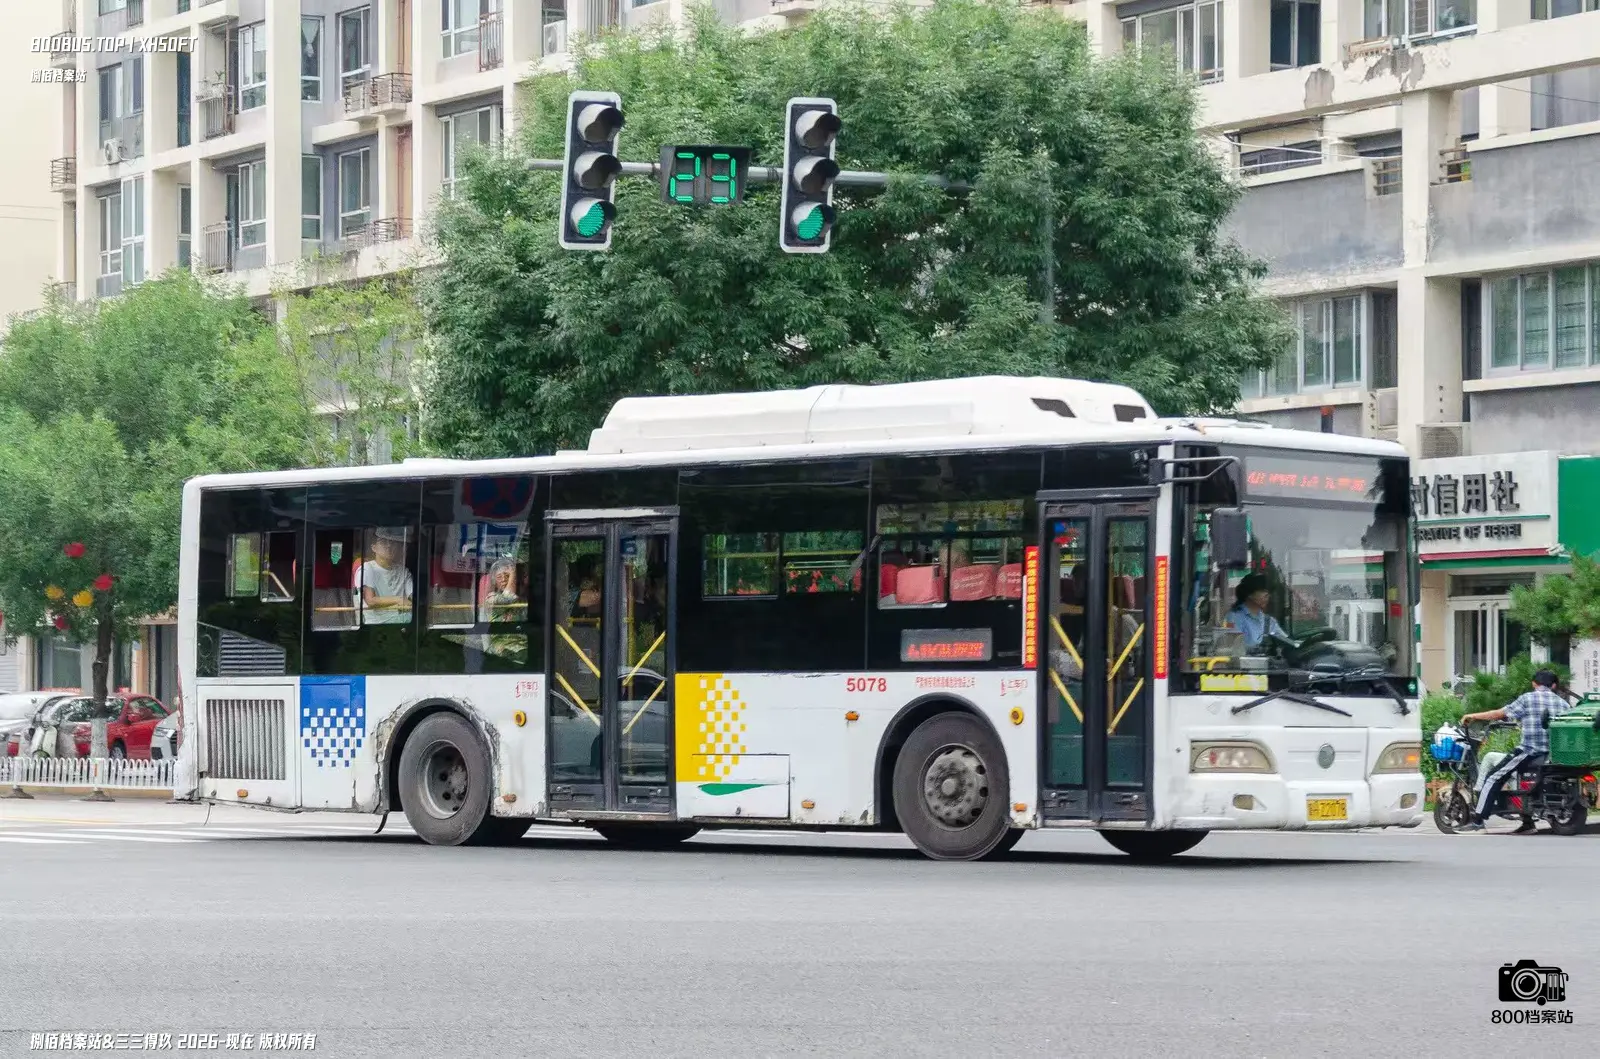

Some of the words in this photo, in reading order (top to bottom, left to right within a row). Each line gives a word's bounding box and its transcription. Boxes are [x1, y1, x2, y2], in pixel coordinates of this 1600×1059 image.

[669, 152, 737, 203] 23
[1410, 470, 1520, 516] 村信用社
[1414, 525, 1461, 542] RATIVE
[1464, 525, 1481, 540] OF
[1485, 523, 1522, 540] HEBEI
[846, 677, 887, 692] 5078
